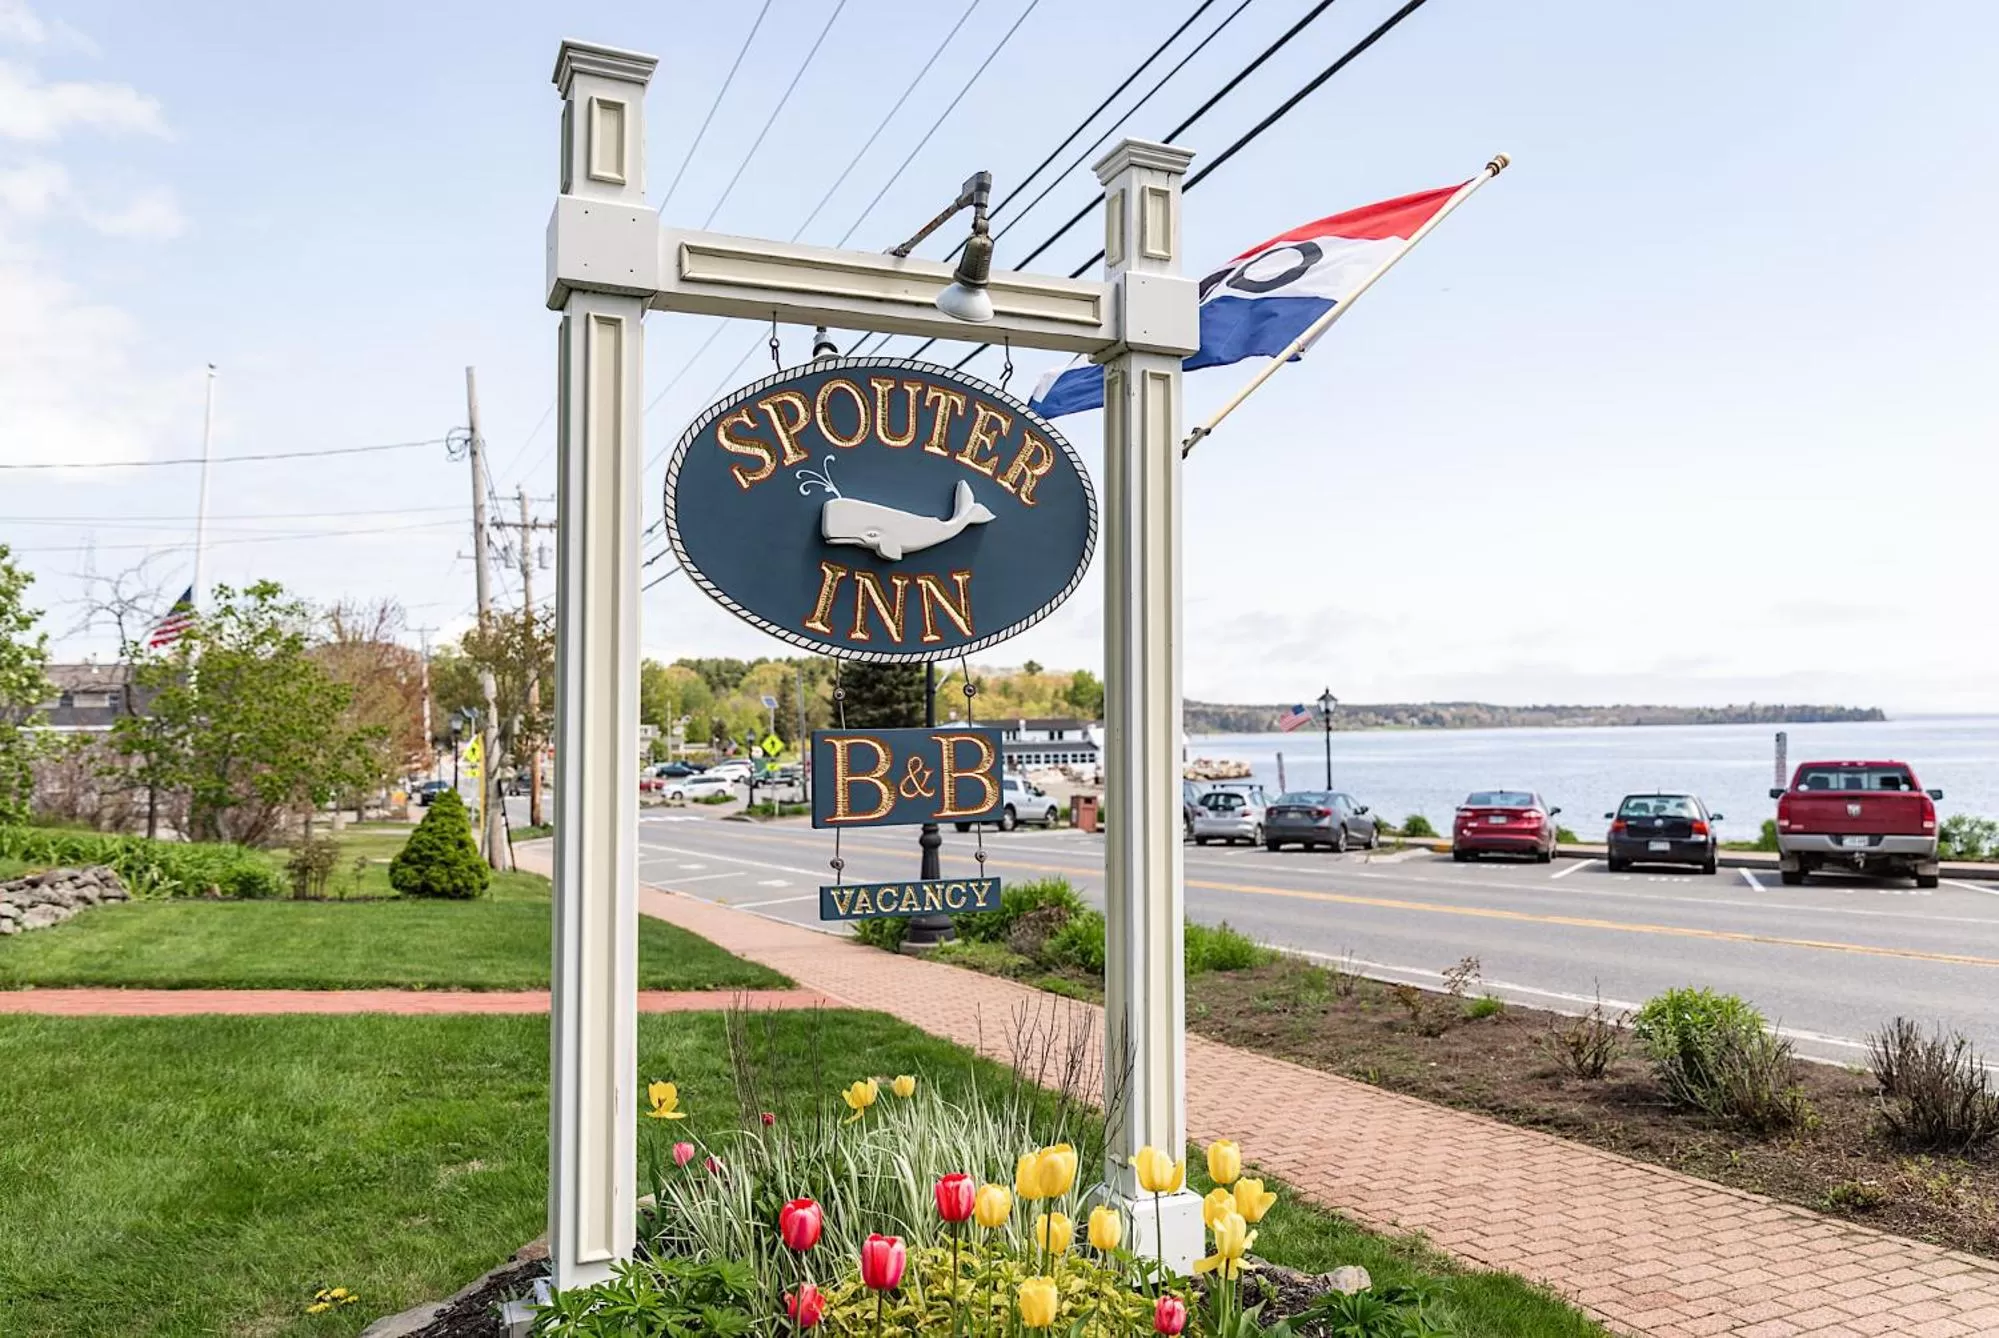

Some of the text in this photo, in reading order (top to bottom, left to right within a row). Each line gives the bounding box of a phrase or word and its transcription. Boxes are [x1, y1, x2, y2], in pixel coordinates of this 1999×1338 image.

[716, 377, 1057, 507] SPOUTER
[804, 560, 976, 643] INN
[823, 733, 1000, 823] B&B
[830, 880, 993, 917] VACANCY
